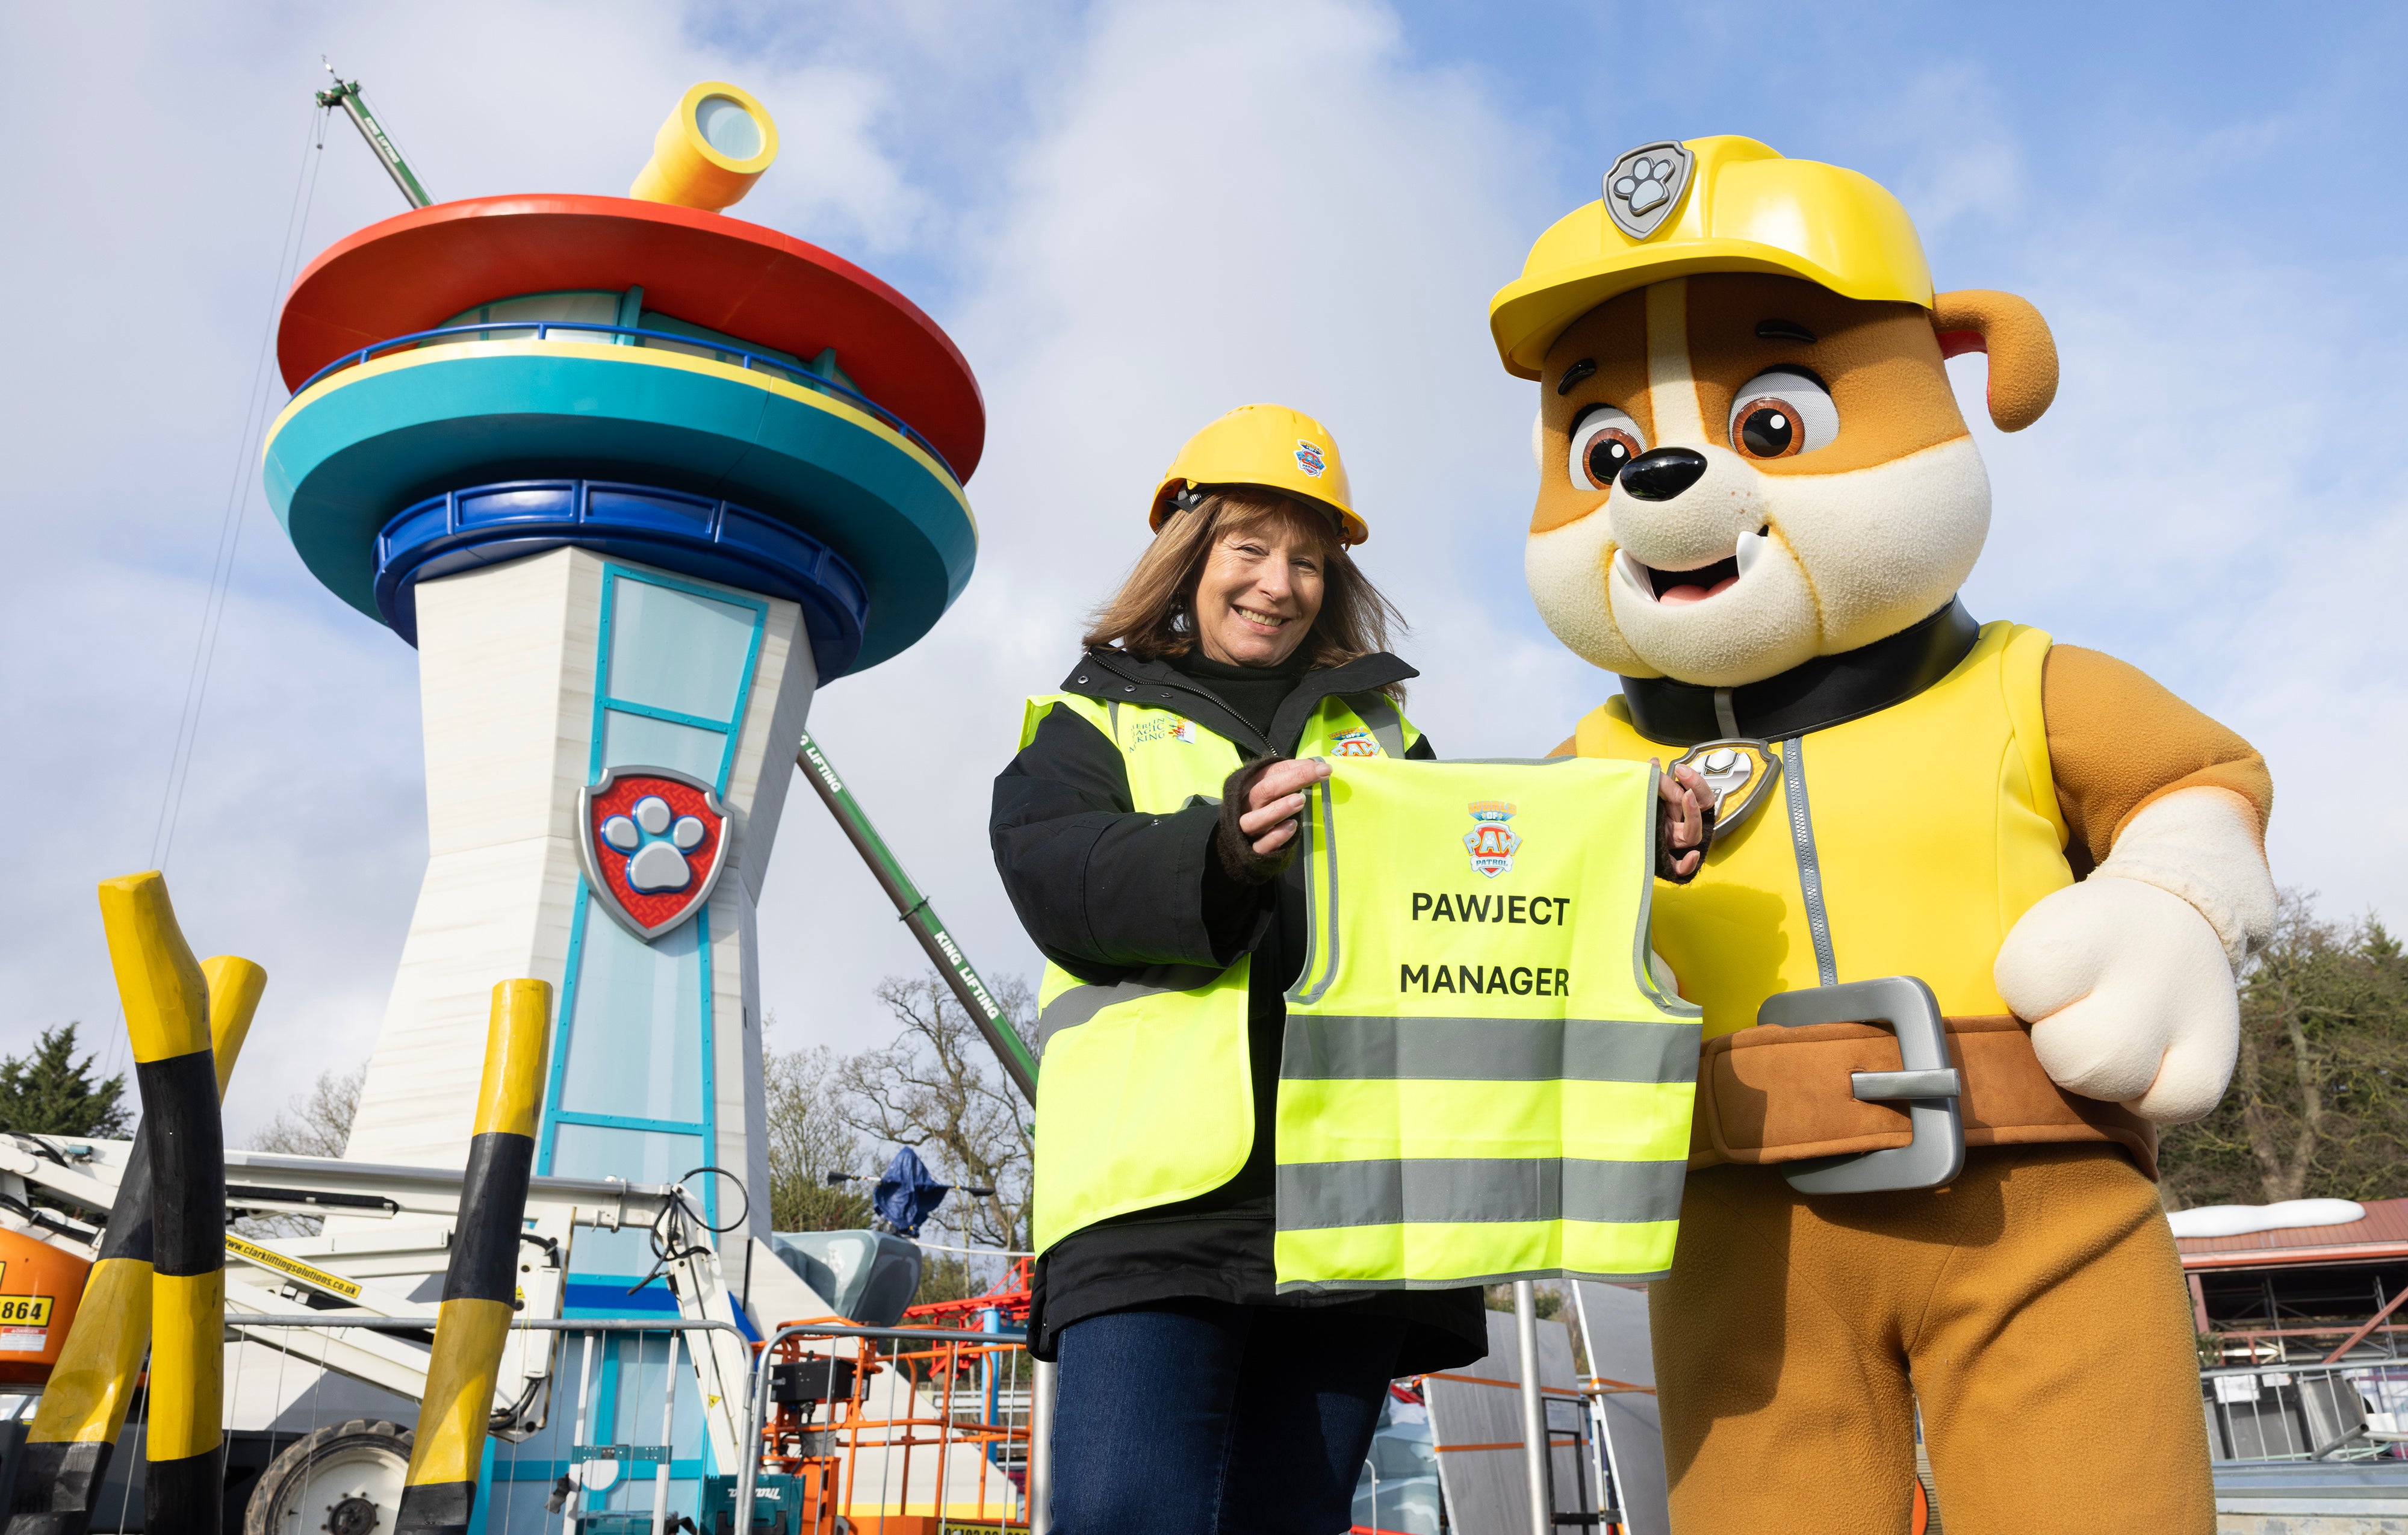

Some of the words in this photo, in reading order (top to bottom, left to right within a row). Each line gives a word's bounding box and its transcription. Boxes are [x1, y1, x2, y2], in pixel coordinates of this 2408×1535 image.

[1296, 451, 1324, 470] PAW
[1131, 722, 1165, 737] AGIC
[1132, 718, 1165, 730] ERLIN
[1330, 742, 1382, 757] PAW
[805, 746, 842, 793] LIFTING
[1468, 801, 1517, 816] WORLD
[1462, 831, 1524, 856] PAW
[1412, 892, 1570, 926] PAWJECT
[934, 931, 963, 966] KING
[958, 966, 1000, 1020] LIFTING
[1401, 964, 1569, 997] MANAGER
